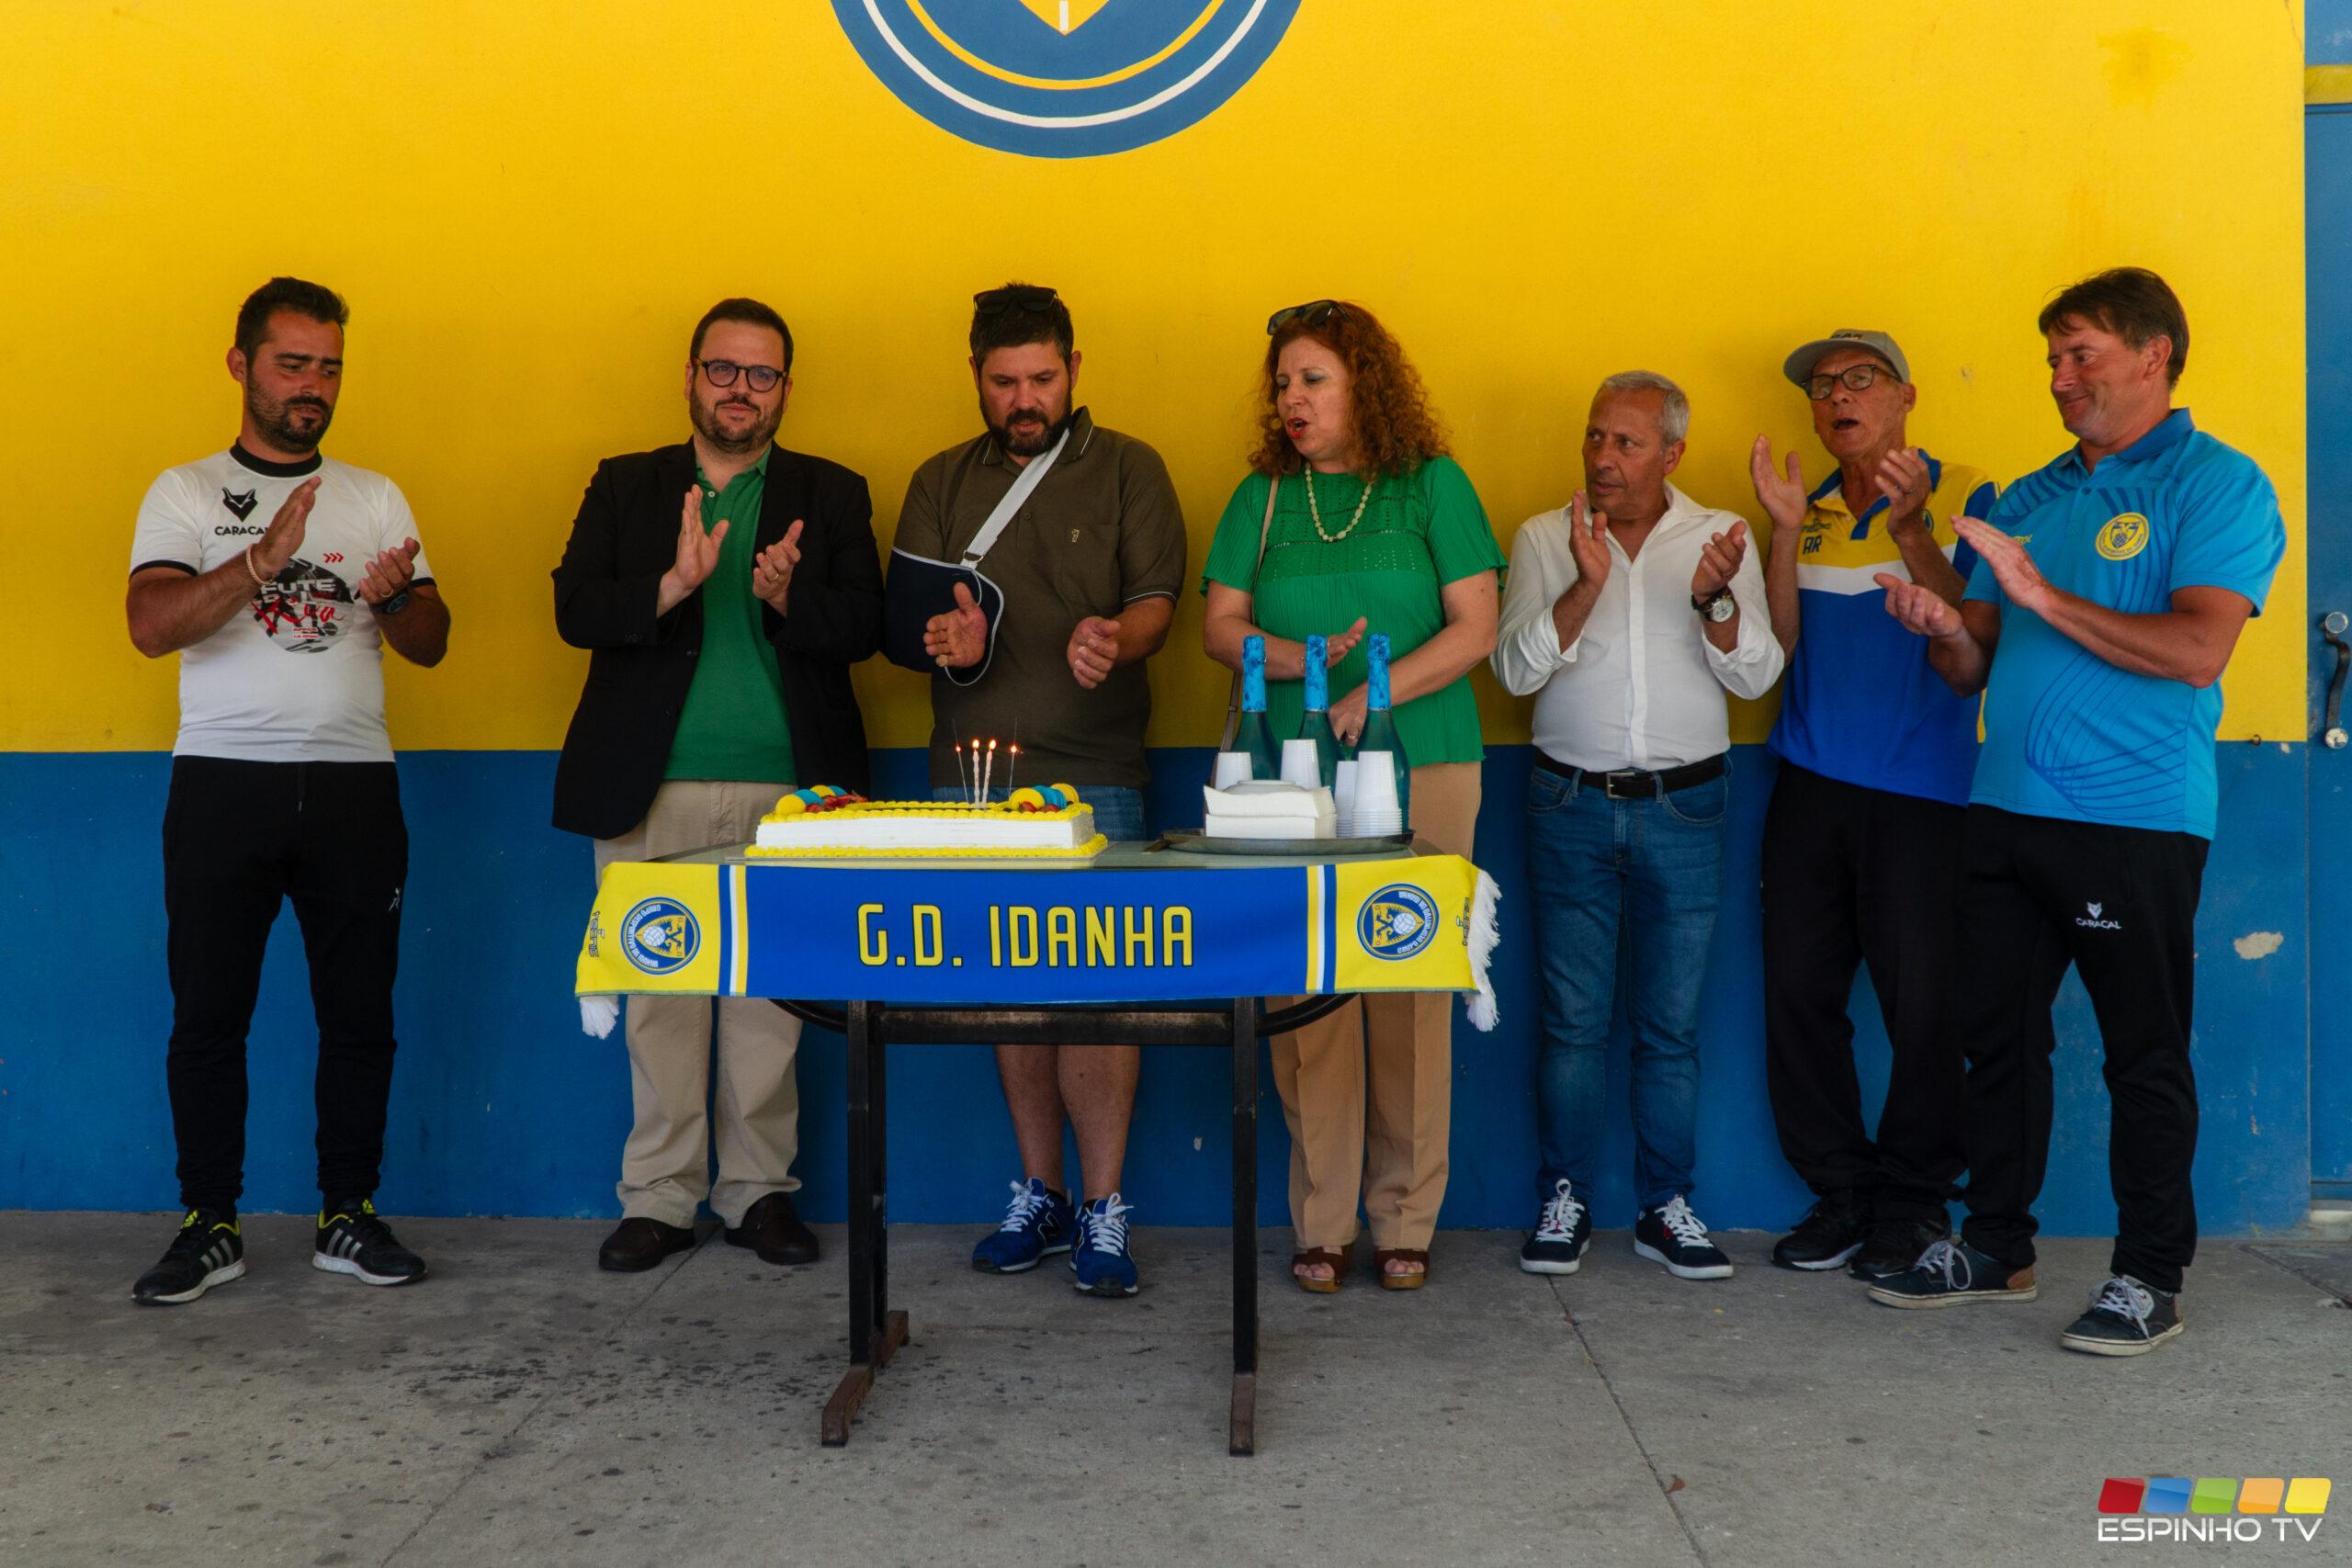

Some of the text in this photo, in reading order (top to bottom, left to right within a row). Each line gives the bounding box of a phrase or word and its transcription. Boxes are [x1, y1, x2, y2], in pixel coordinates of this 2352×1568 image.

[214, 525, 267, 536] CARACA
[1803, 536, 1823, 555] AR
[2075, 918, 2122, 930] CARACAL
[857, 903, 1193, 966] G.D. IDANHA
